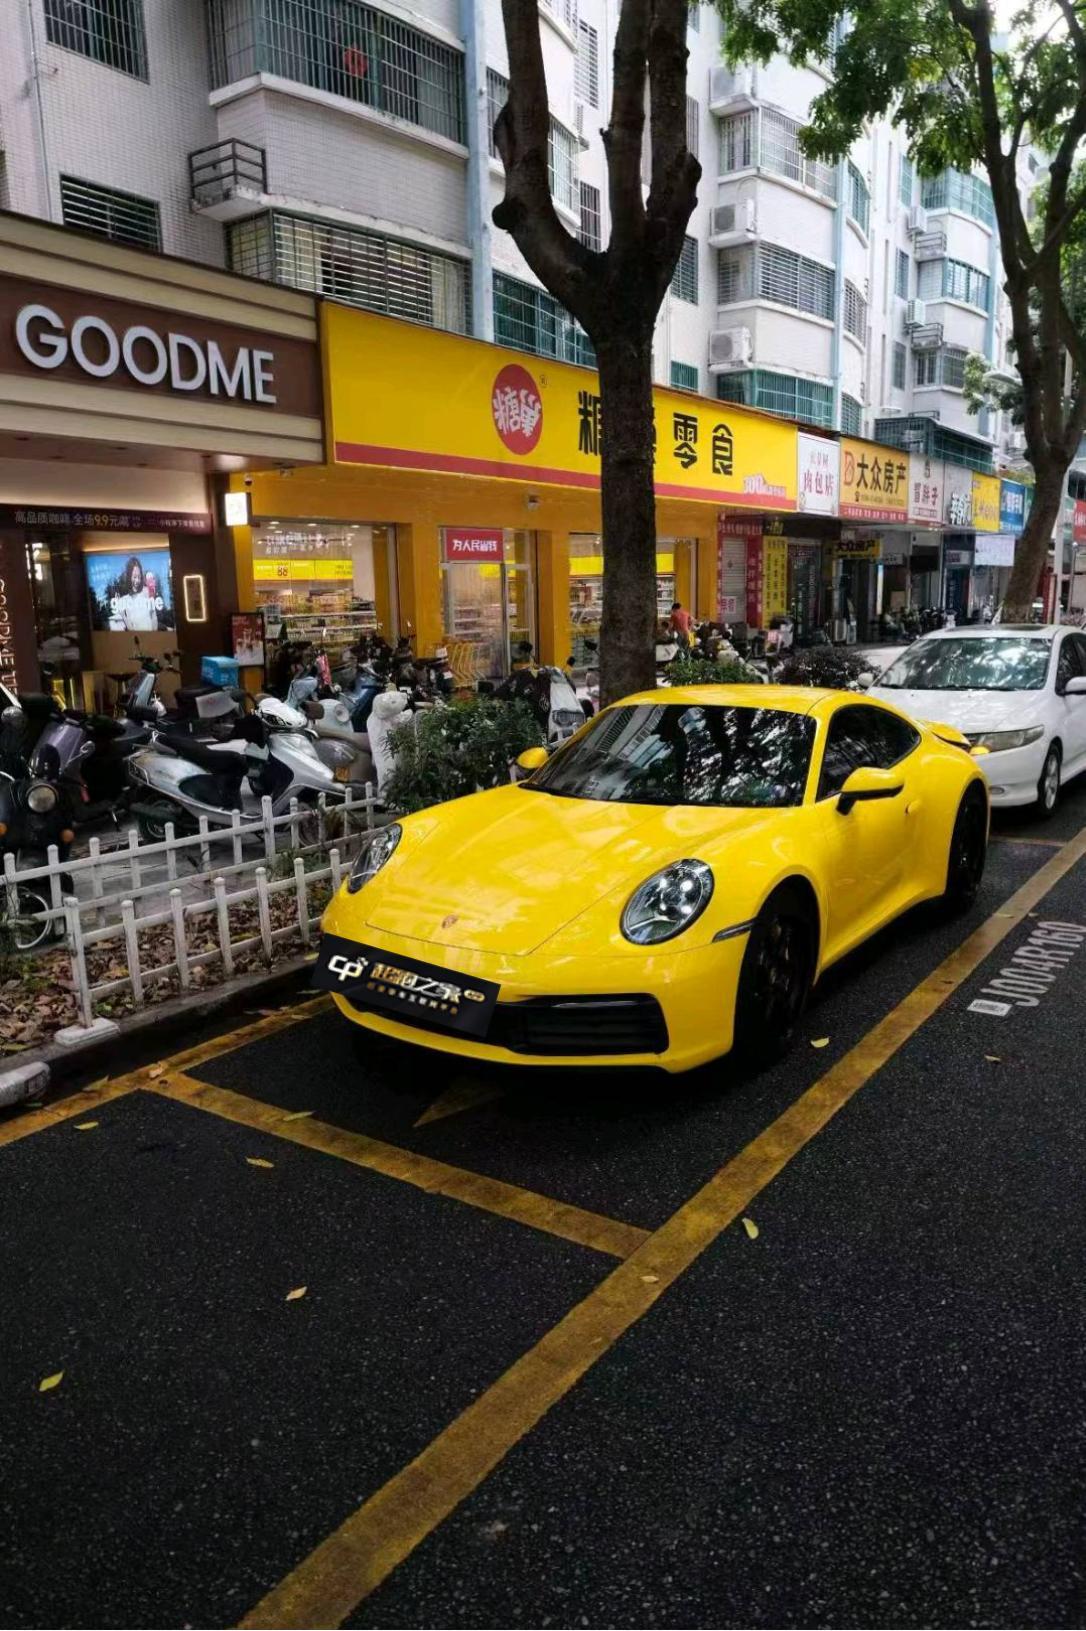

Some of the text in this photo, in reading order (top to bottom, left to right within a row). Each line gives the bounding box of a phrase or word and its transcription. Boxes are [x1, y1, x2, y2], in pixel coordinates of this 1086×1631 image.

[15, 304, 277, 404] GOODME
[578, 390, 734, 476] 糖零食
[803, 468, 835, 496] 肉包店
[856, 452, 907, 495] 大众房产
[452, 538, 498, 552] 为人民省钱
